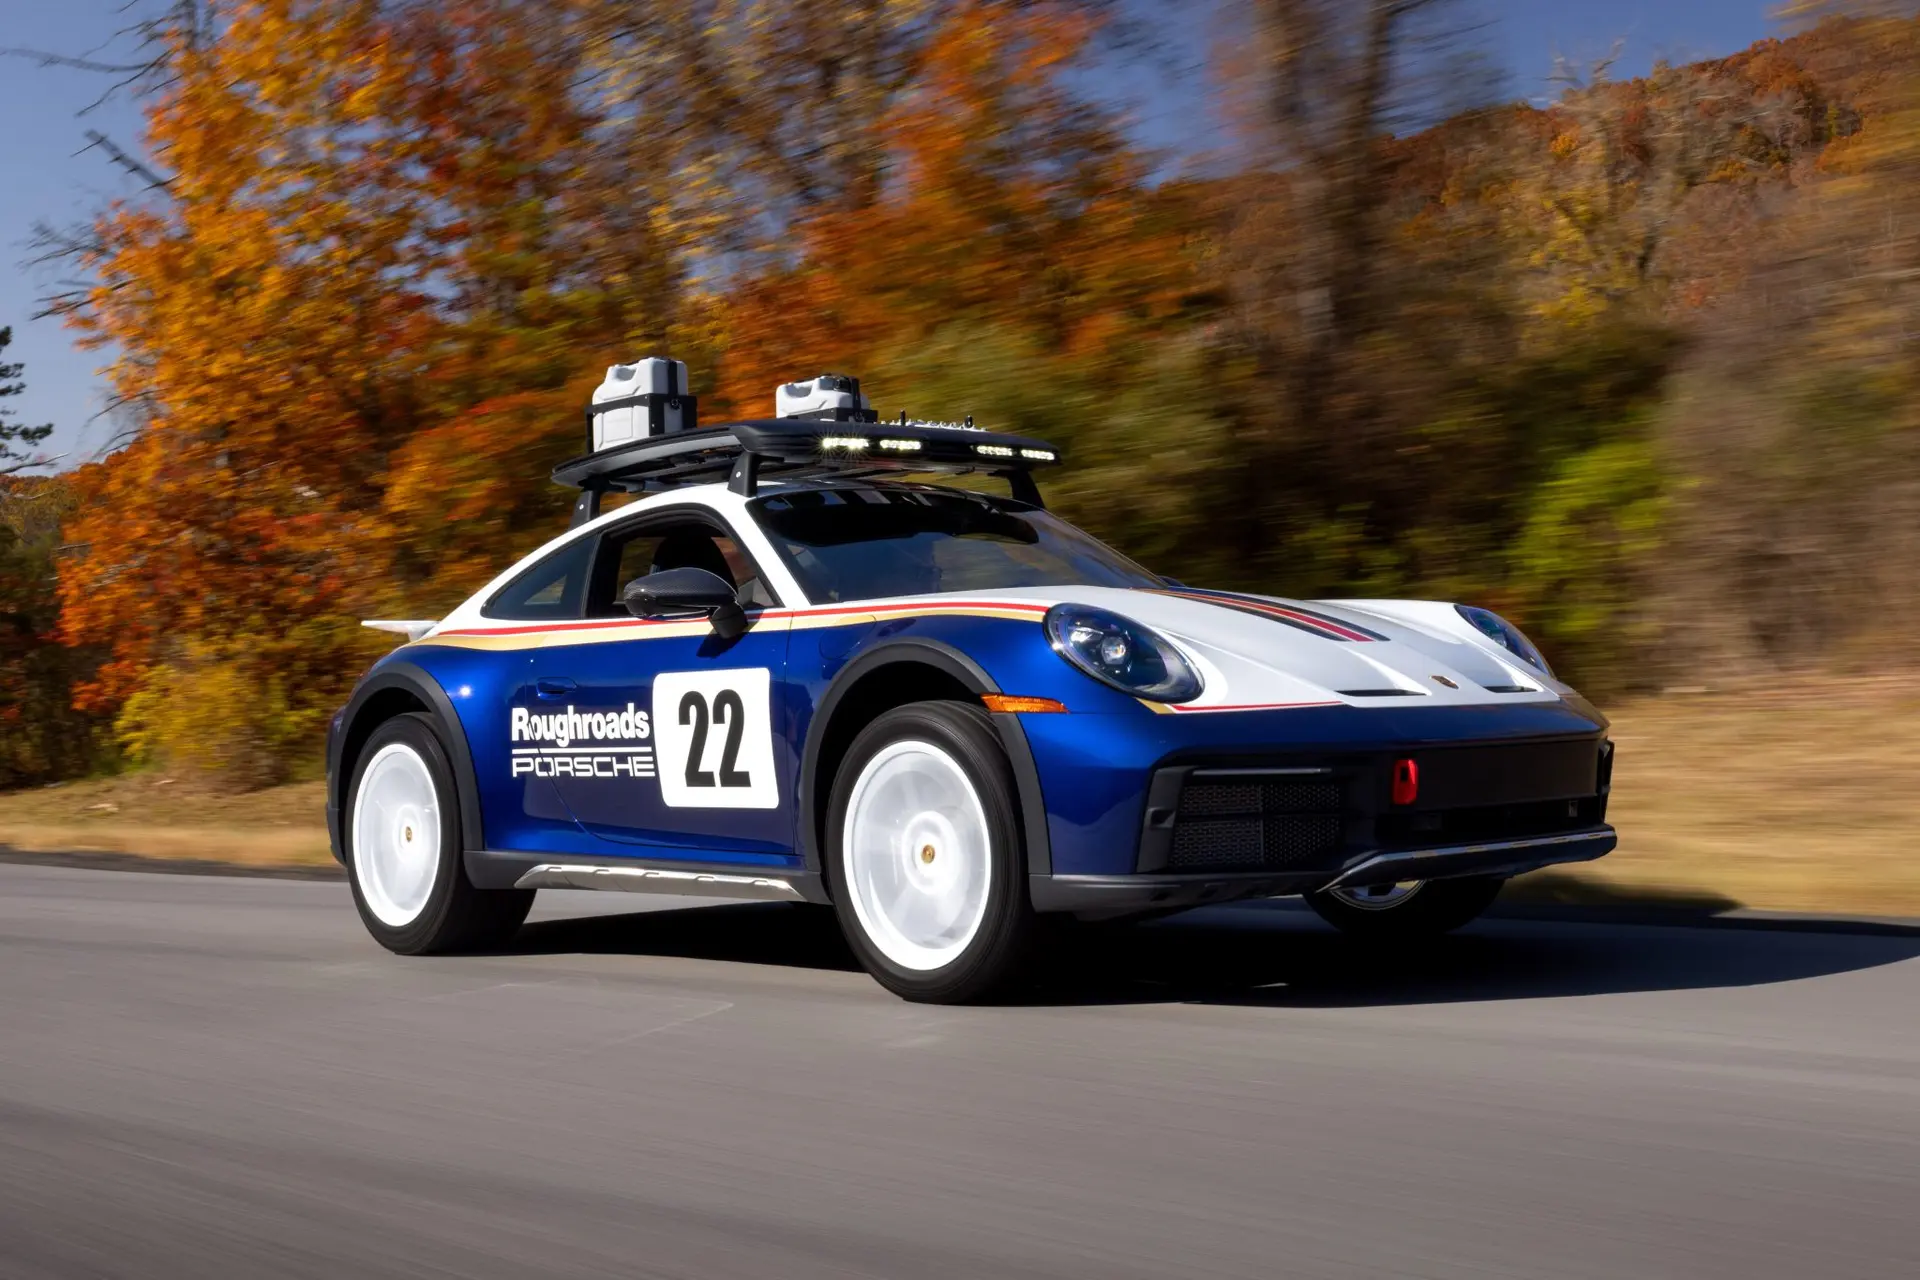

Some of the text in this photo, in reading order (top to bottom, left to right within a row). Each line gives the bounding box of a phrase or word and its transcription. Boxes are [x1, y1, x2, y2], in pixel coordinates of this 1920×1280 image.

[511, 702, 650, 748] Roughroads
[678, 689, 752, 787] 22
[512, 756, 656, 777] PORSCHE
